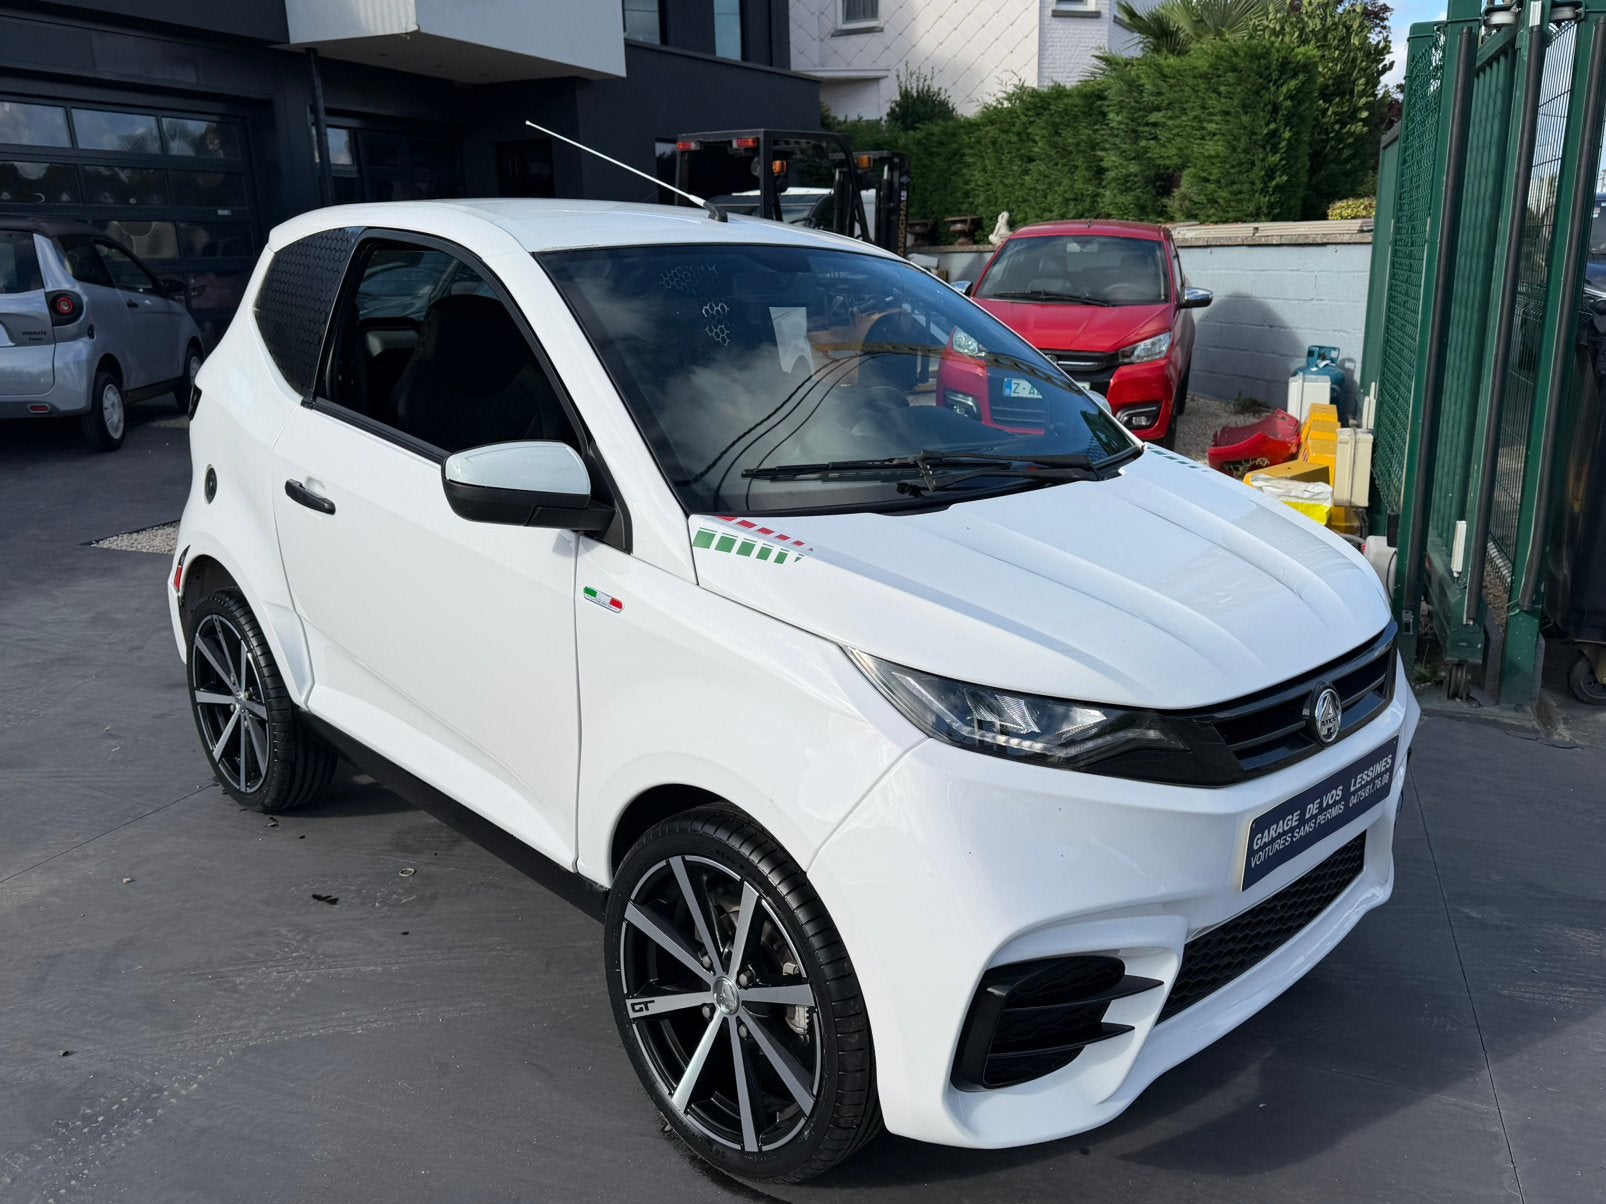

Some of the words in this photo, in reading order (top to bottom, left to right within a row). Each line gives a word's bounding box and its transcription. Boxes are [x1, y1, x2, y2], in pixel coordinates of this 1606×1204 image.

[1251, 833, 1292, 868] VOITURES
[1293, 819, 1316, 841] SANS
[1315, 801, 1345, 828] PERMIS
[1253, 811, 1300, 850] GARAGE
[1305, 798, 1321, 820] DE
[1322, 785, 1343, 808] VOS
[1350, 754, 1392, 792] LESSINES
[630, 999, 655, 1013] GT
